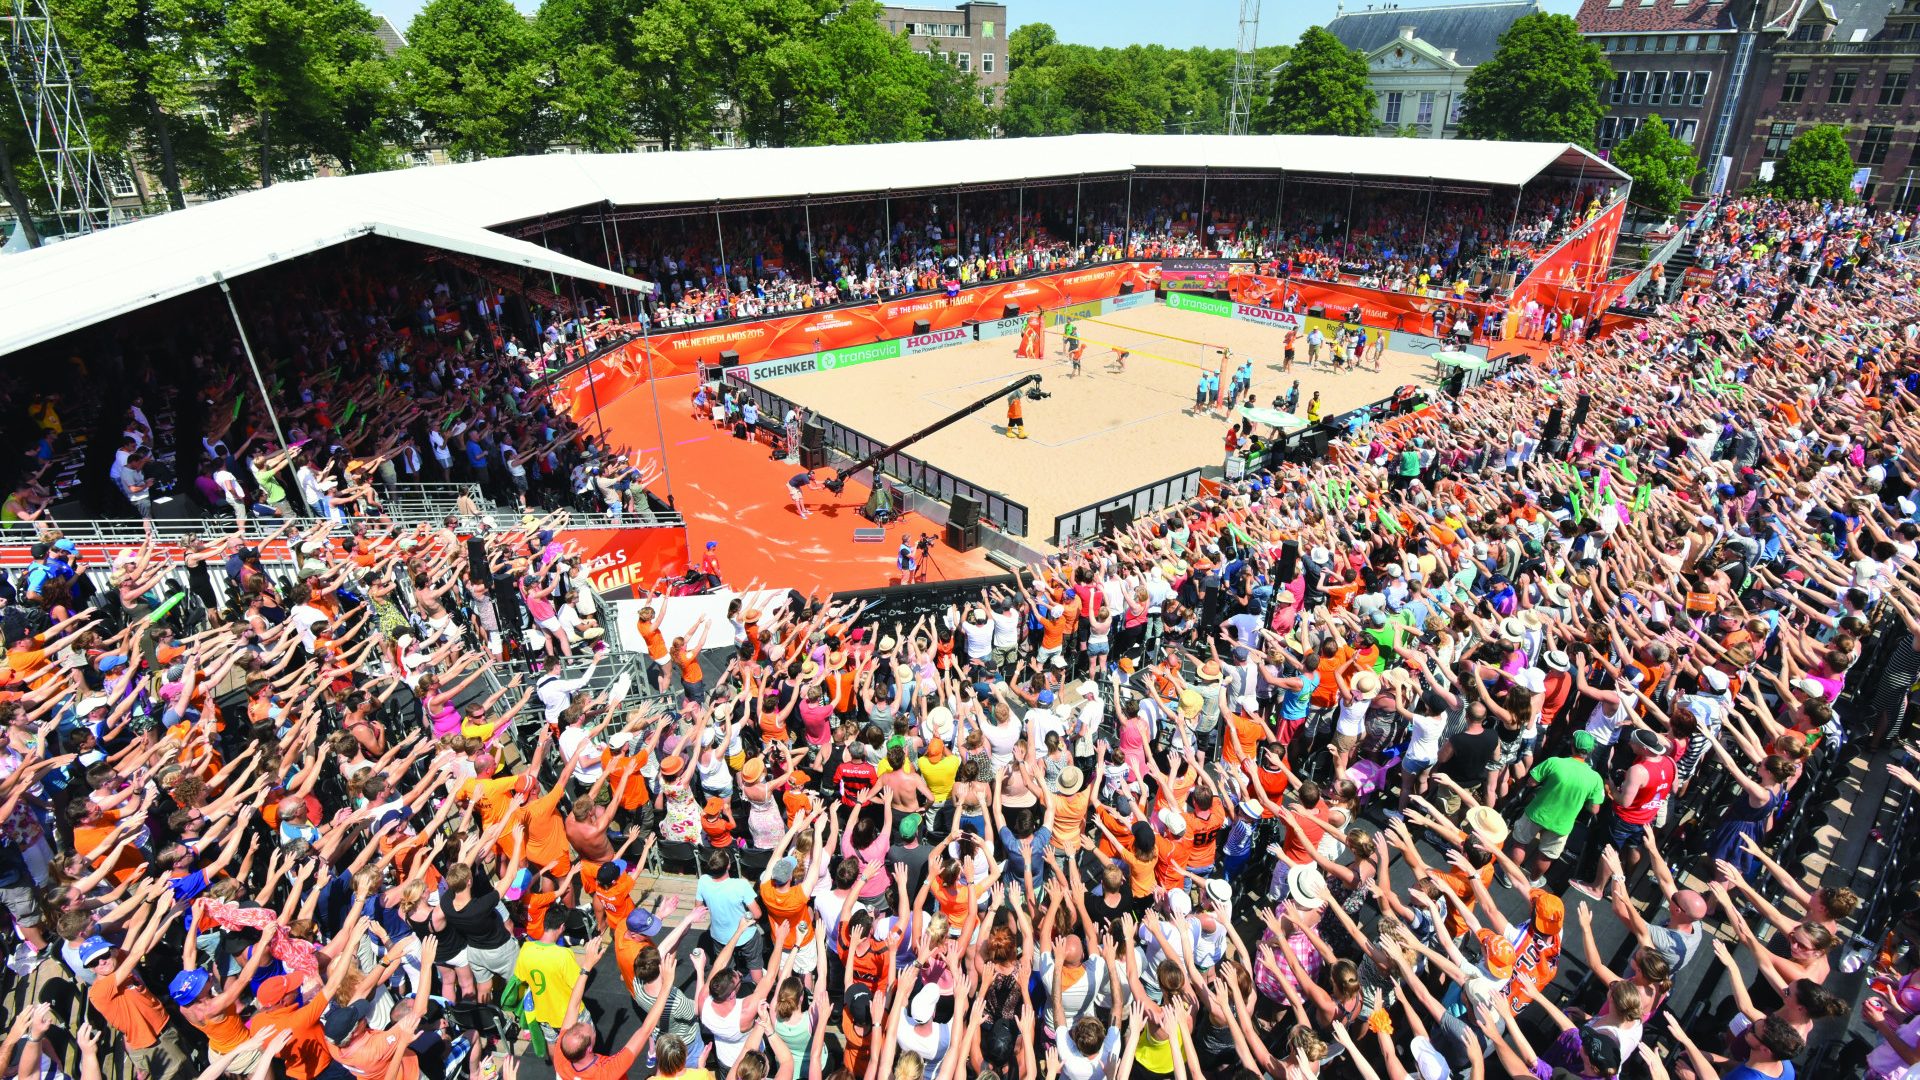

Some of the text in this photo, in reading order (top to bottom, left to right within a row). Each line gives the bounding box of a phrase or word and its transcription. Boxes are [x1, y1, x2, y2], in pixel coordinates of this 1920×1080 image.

[1063, 277, 1073, 286] THE
[900, 305, 911, 314] THE
[912, 302, 933, 312] FINALS
[934, 298, 949, 310] THE
[949, 294, 975, 306] HAGUE
[1182, 295, 1229, 314] transavia
[1365, 308, 1389, 319] HAGUE
[997, 316, 1028, 329] SONY
[1238, 305, 1298, 325] HONDA
[672, 328, 765, 350] THE NETHERLANDS 2015
[906, 329, 967, 348] HONDA
[839, 344, 897, 364] transavia
[754, 360, 815, 380] SCHENKER
[529, 968, 547, 995] 9
